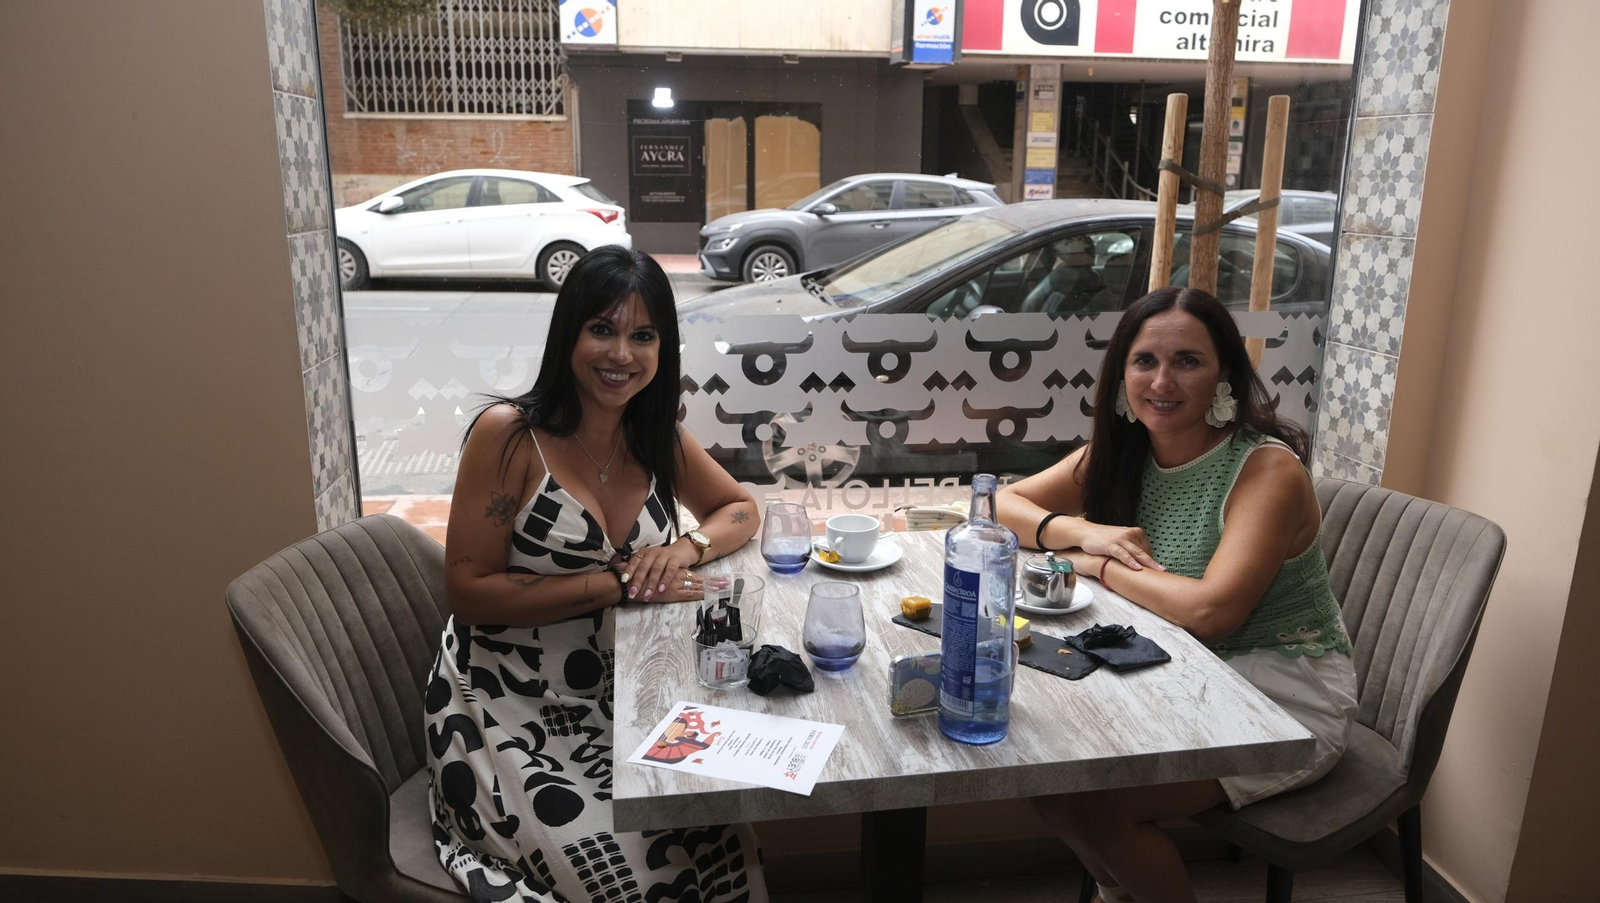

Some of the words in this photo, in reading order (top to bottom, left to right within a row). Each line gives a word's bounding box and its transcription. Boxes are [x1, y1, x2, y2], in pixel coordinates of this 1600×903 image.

[1159, 9, 1278, 28] comcial
[915, 41, 952, 49] formación
[1176, 32, 1275, 53] altira
[641, 150, 685, 162] AYORA
